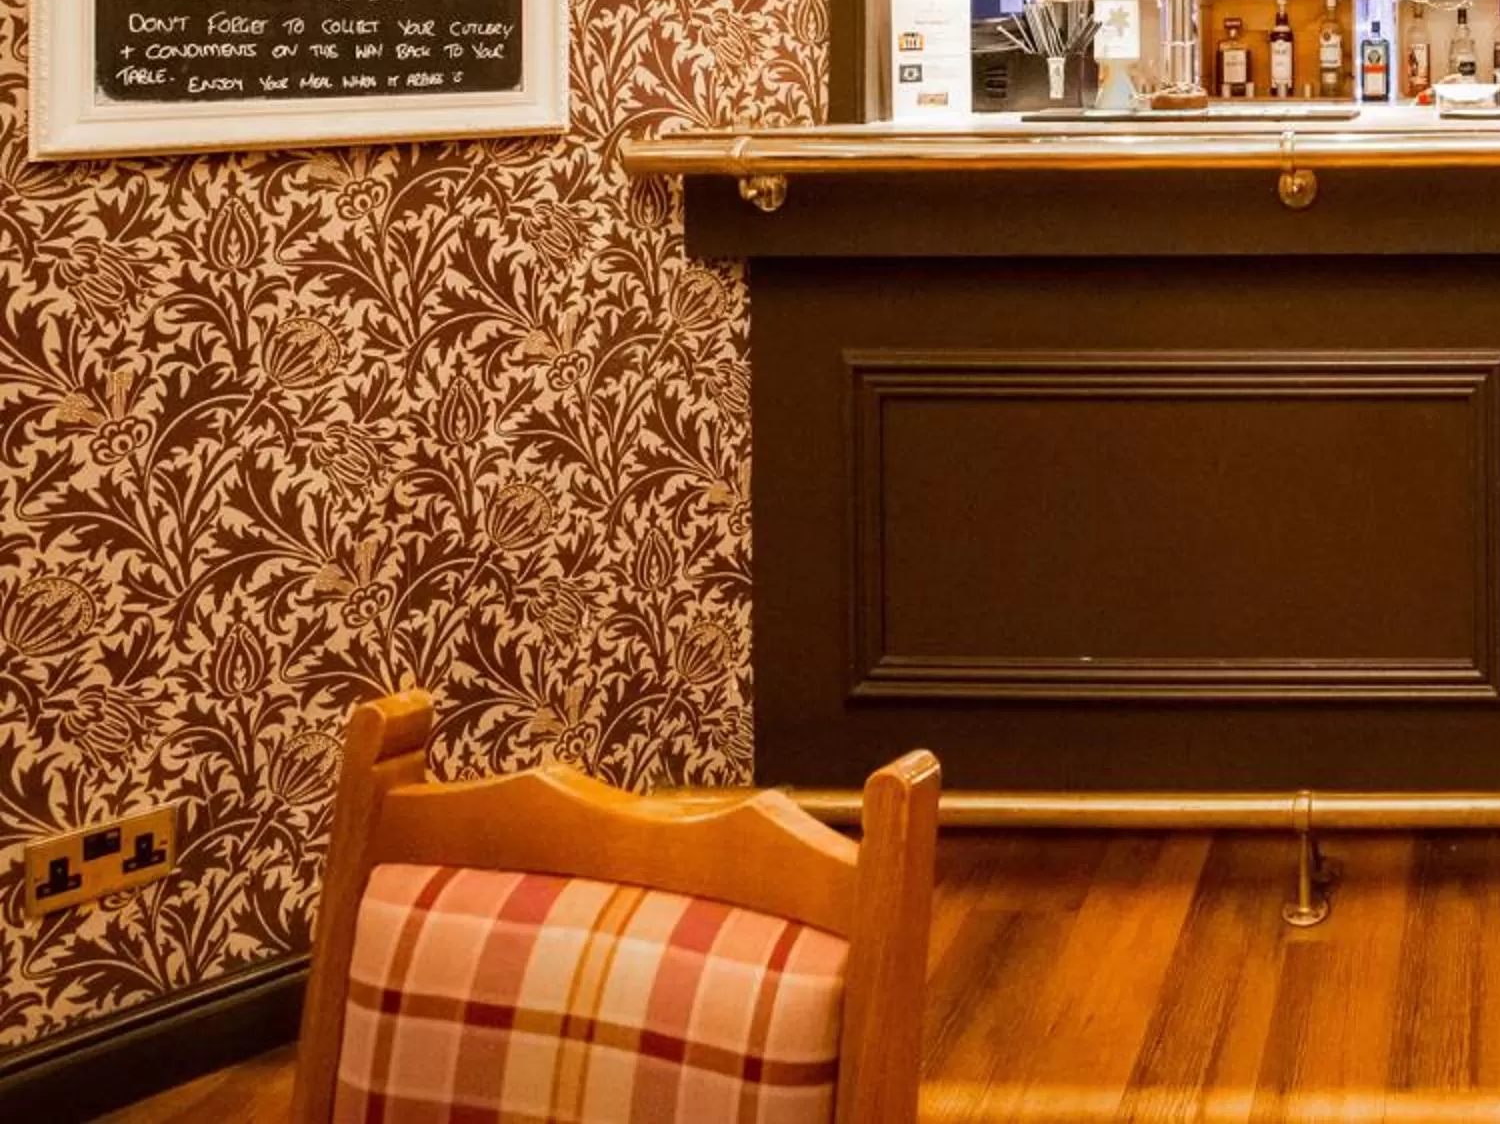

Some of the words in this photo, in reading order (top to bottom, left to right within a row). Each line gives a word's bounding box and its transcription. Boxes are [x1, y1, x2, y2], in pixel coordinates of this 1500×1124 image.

[129, 13, 191, 34] DON'T
[207, 11, 269, 35] FORGET
[282, 17, 305, 36] TO
[321, 18, 381, 35] COLLECT
[397, 18, 436, 37] YOUR
[449, 21, 514, 40] CUTLERY
[120, 45, 136, 60] +
[145, 42, 257, 60] CONDIMENTS
[271, 43, 299, 59] ON
[355, 43, 384, 59] WAY
[395, 43, 432, 60] BACK
[443, 43, 464, 59] TO
[472, 41, 505, 59] YOUR
[187, 76, 243, 93] ENJOY
[259, 75, 288, 91] YOUR
[300, 73, 333, 90] MEAL
[342, 73, 376, 90] WHEN
[387, 75, 400, 87] IT
